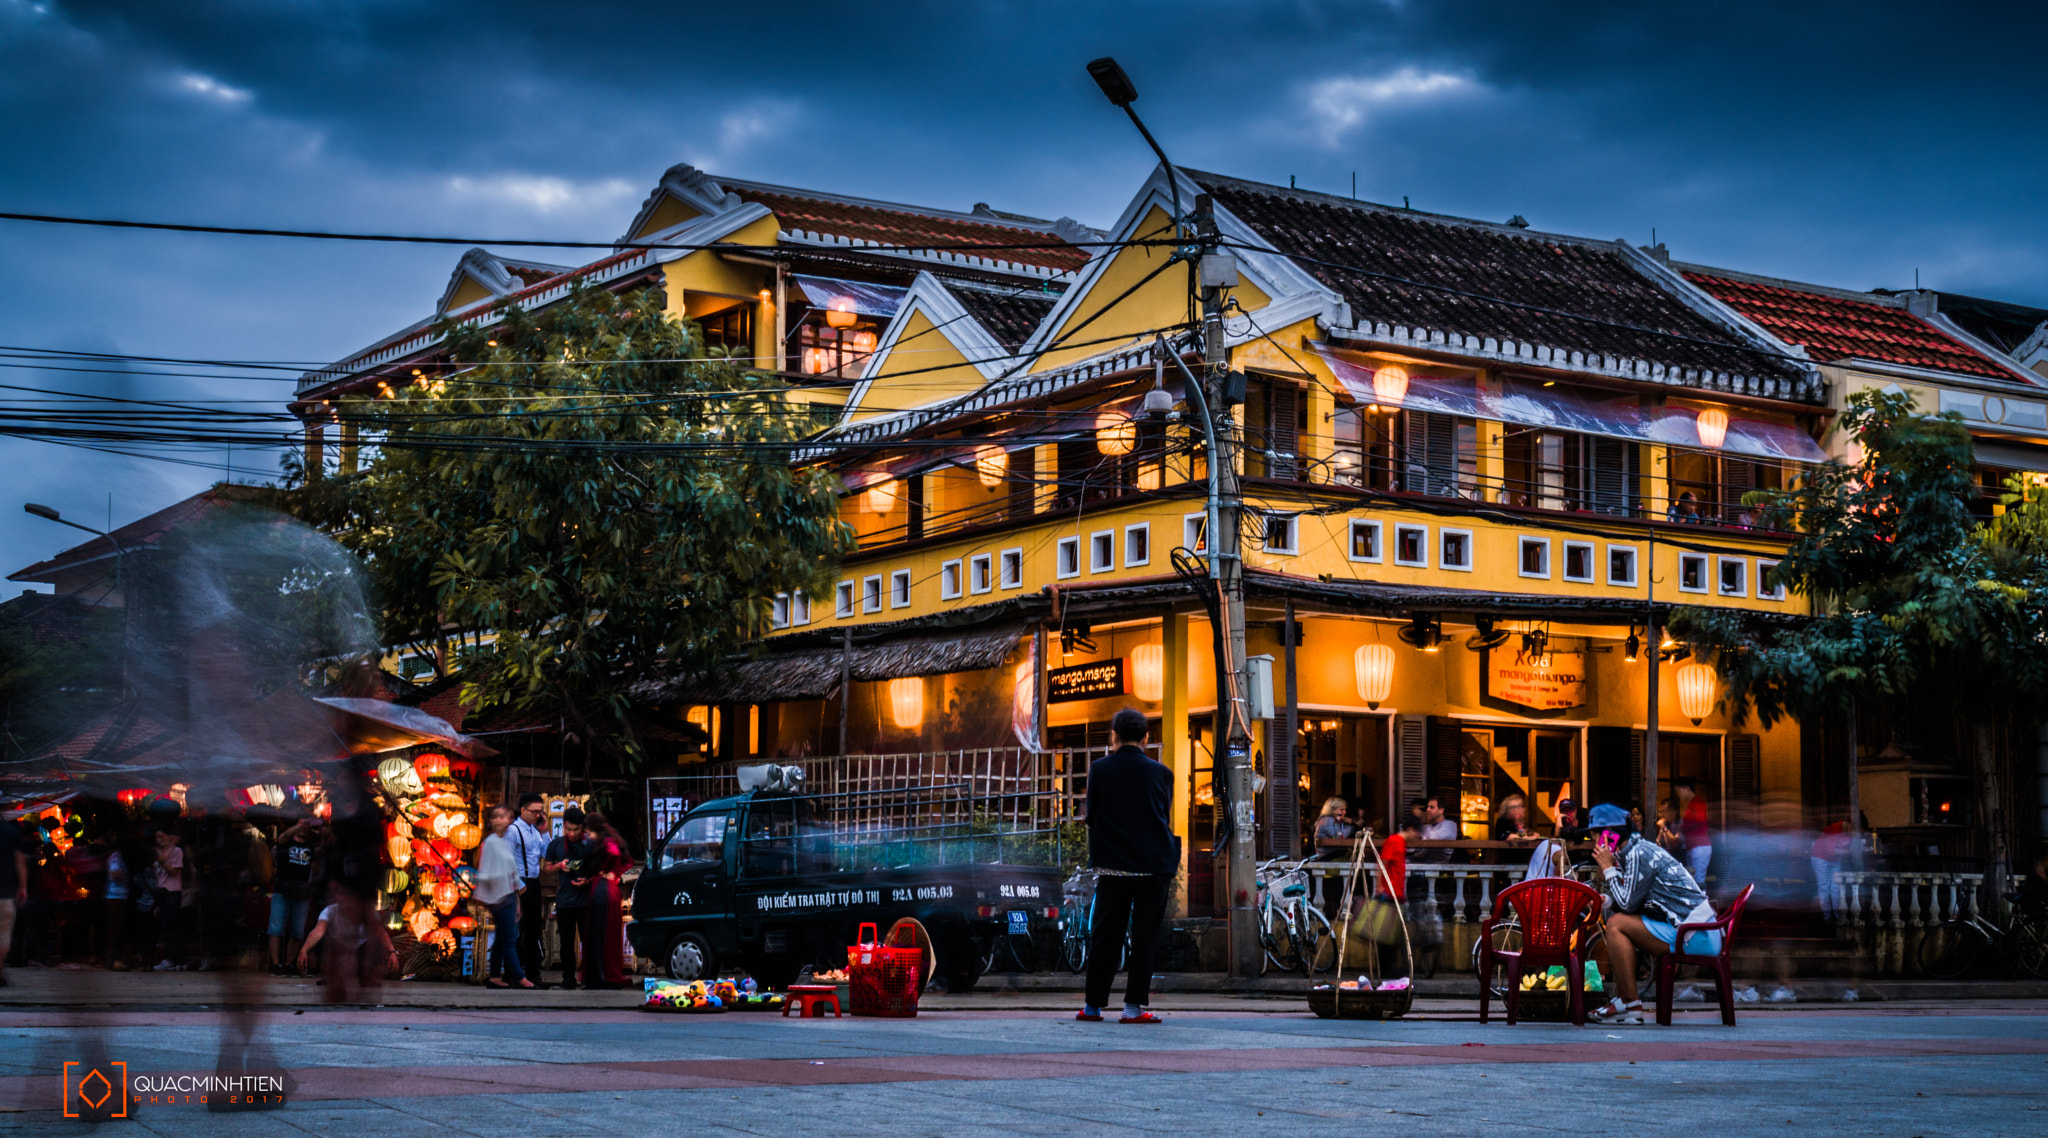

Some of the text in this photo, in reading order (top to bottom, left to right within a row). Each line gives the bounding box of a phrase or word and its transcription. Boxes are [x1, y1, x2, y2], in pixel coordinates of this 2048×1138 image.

[1051, 665, 1117, 687] mango.mango
[757, 886, 953, 911] ĐỘI KIỂM TRA TRẬT TỰ ĐÔ THỊ 92A 005.03
[1000, 884, 1040, 898] 92A 005.03
